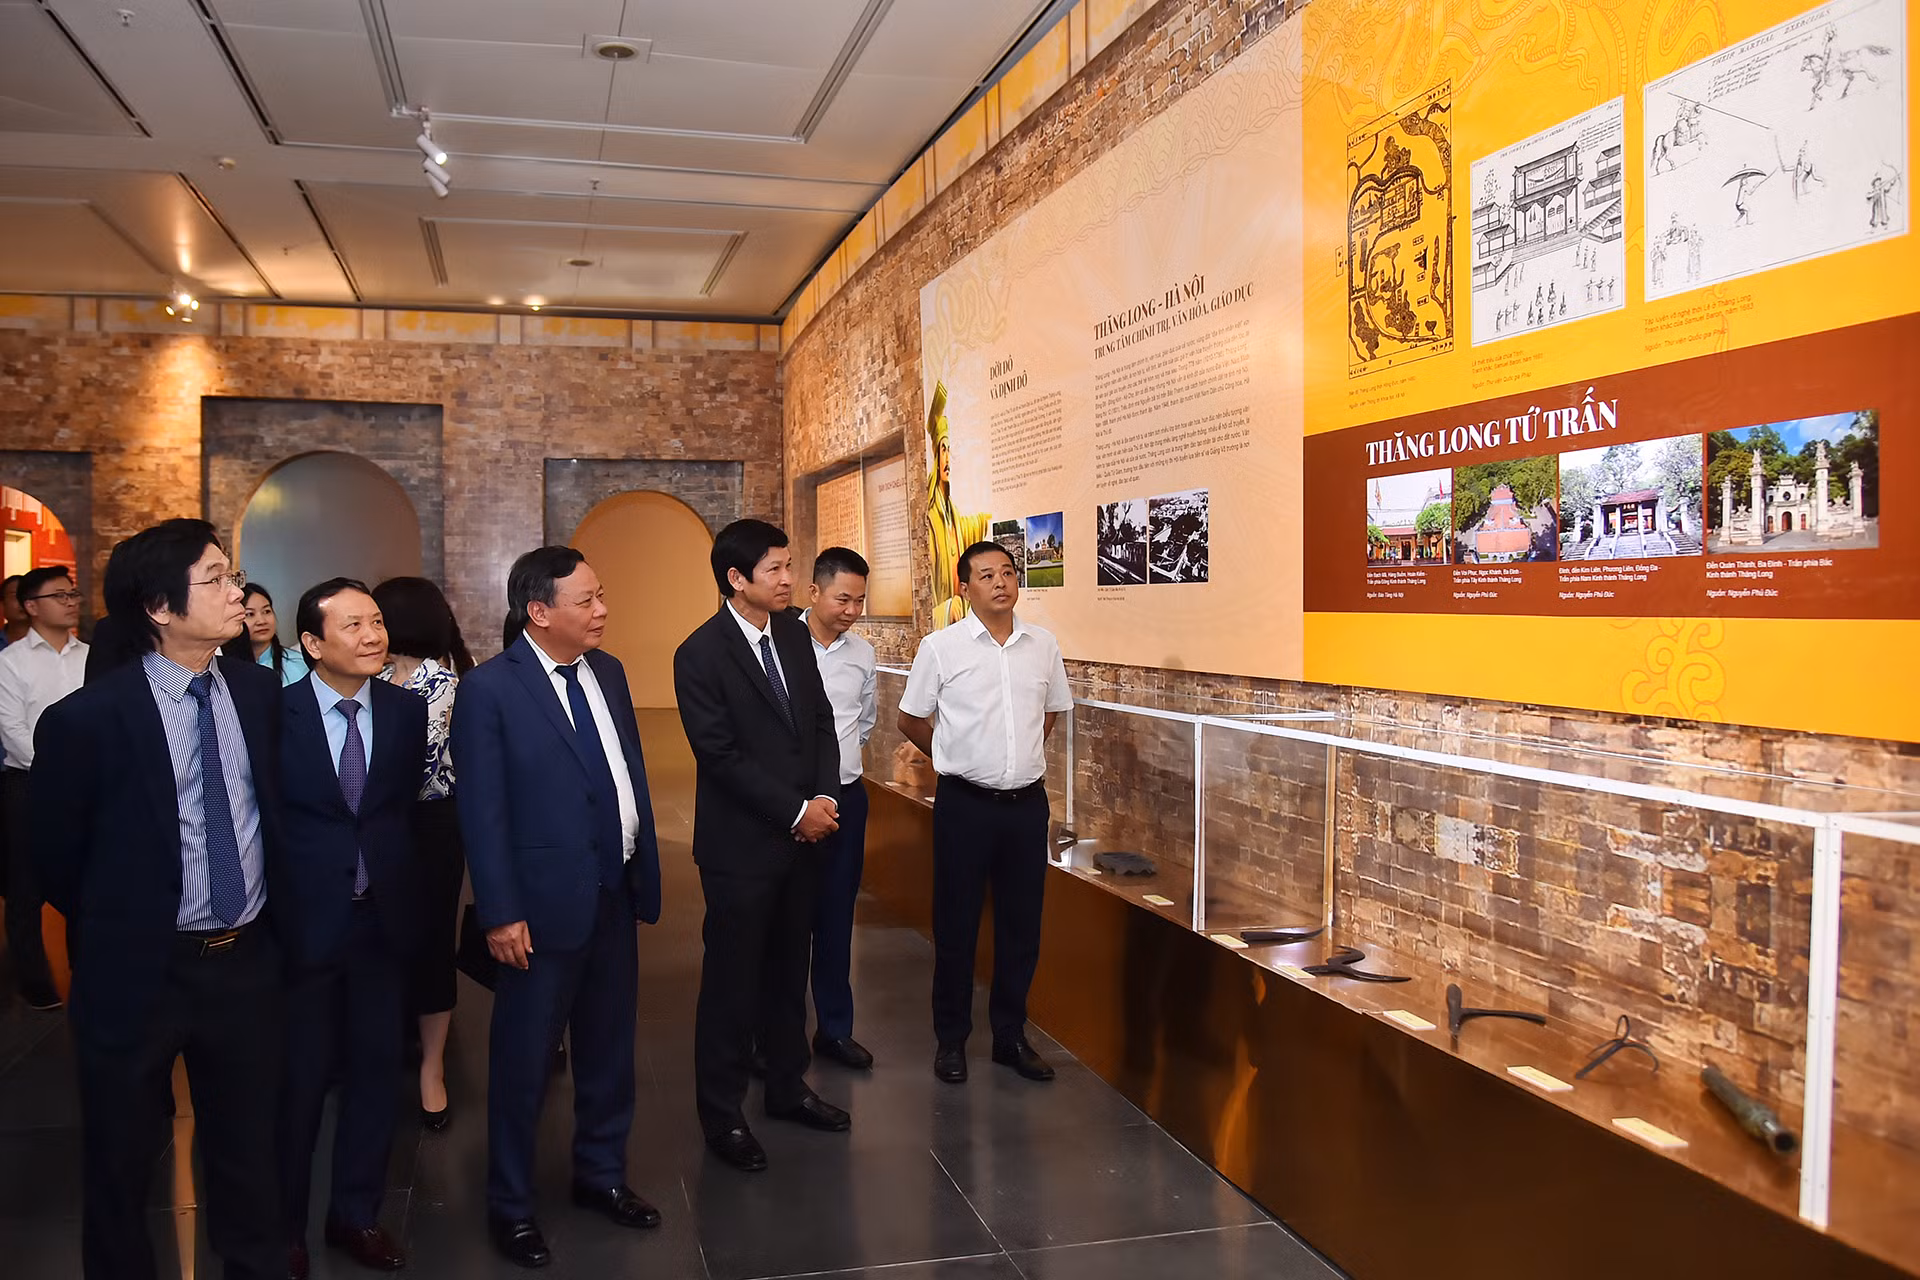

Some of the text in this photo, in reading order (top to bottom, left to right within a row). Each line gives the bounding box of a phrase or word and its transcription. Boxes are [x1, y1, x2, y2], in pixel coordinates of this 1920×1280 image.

[1093, 314, 1126, 340] THĂNG
[1128, 298, 1156, 326] LONG
[1165, 282, 1181, 311] HÀ
[1183, 274, 1206, 302] NỘI
[1094, 340, 1116, 360] TRUNG
[1116, 334, 1131, 350] TÂM
[1132, 324, 1155, 345] CHÍNH
[1172, 310, 1188, 327] VĂN
[1210, 290, 1233, 312] GIÁO
[1234, 282, 1254, 302] DỤC
[1365, 386, 1619, 466] THĂNG LONG TỨ TRẤN
